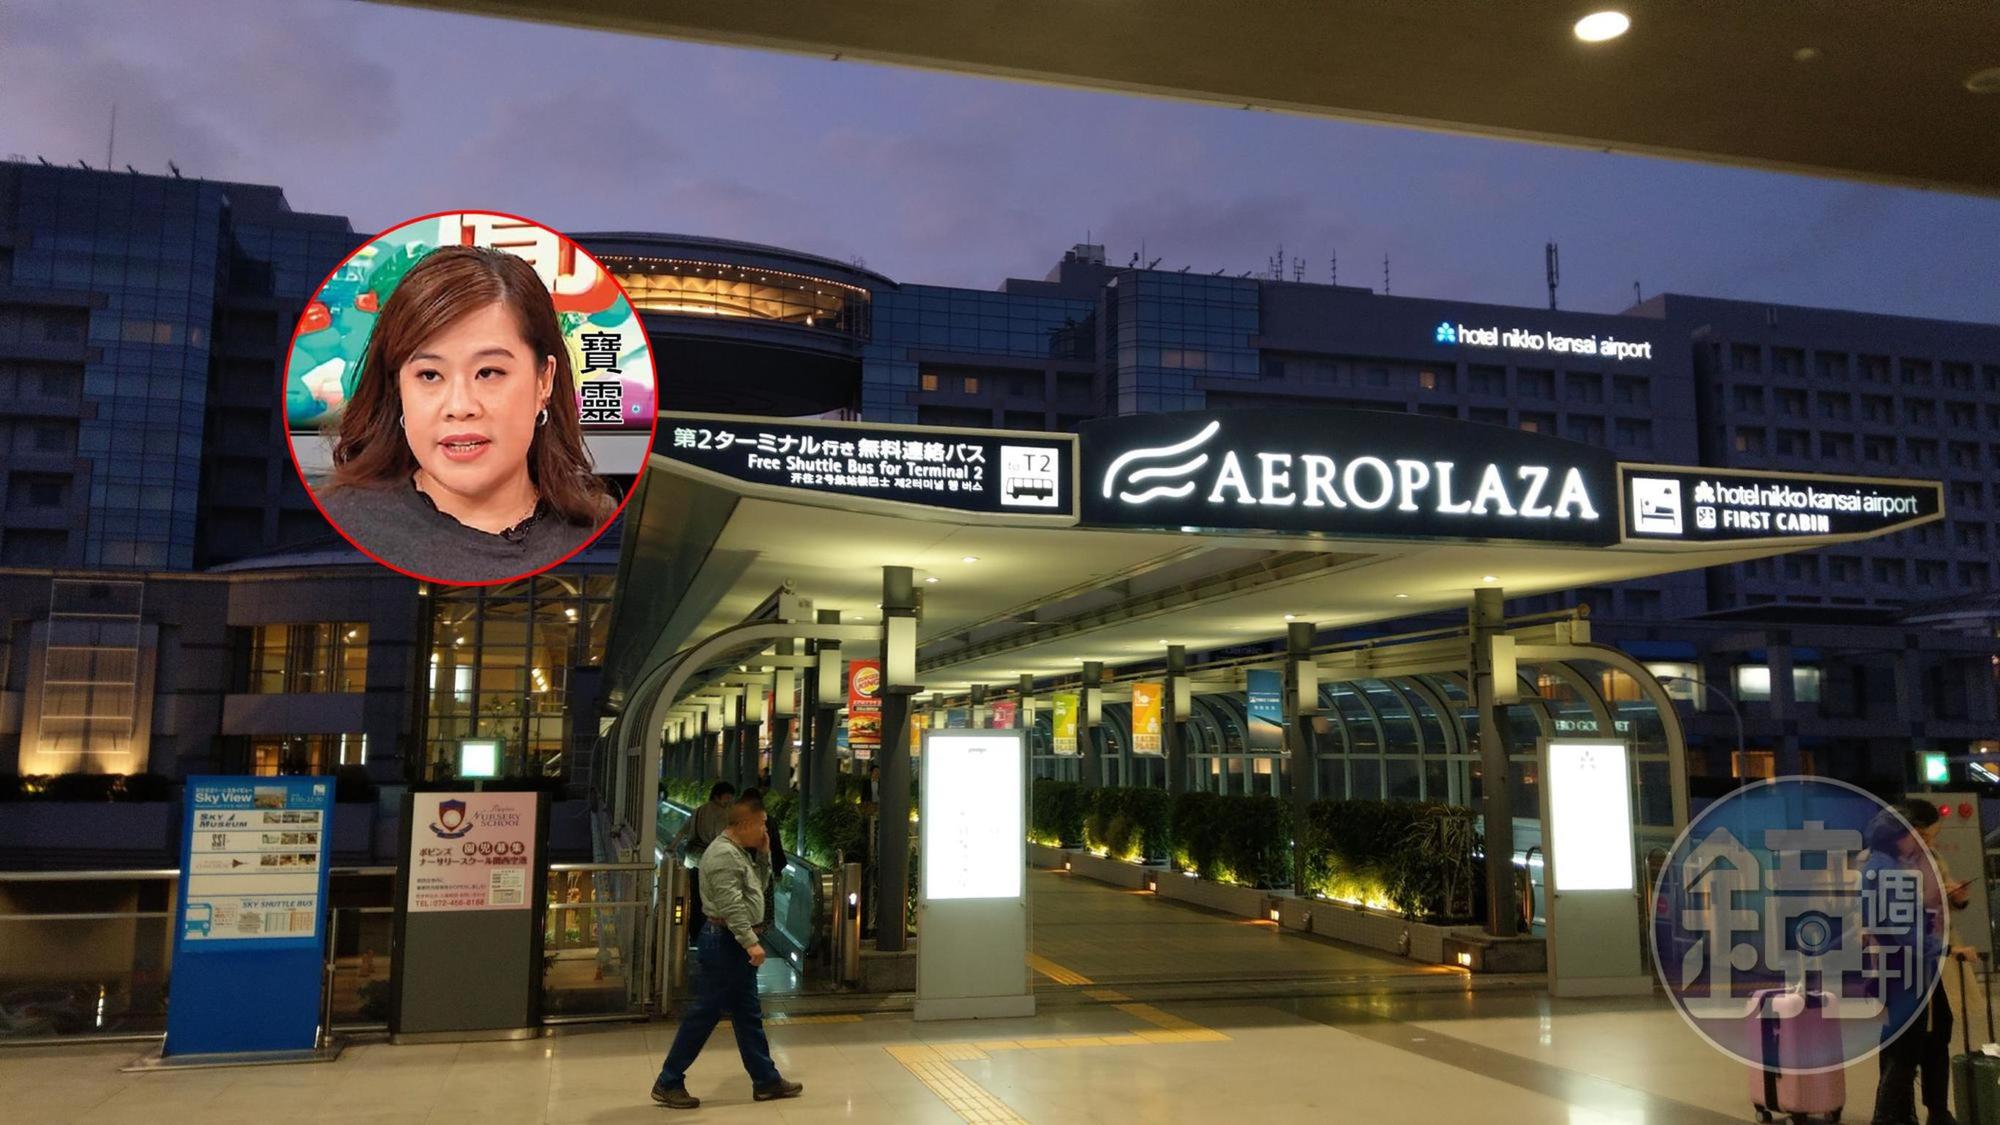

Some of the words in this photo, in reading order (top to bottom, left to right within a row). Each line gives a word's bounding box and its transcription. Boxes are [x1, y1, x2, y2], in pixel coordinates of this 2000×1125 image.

[1458, 323, 1498, 347] hotel
[1502, 328, 1544, 350] nikko
[1547, 331, 1597, 354] kansai
[1600, 336, 1652, 360] airport
[858, 437, 985, 463] 無料連絡バス
[748, 453, 781, 470] Free
[786, 455, 842, 474] Shuttle
[850, 459, 877, 476] Bus
[879, 460, 901, 477] for
[908, 462, 968, 479] Terminal
[973, 466, 983, 480] 2
[894, 477, 945, 491] 제2터미널
[948, 480, 959, 492] 행
[961, 481, 984, 492] 버스
[1207, 450, 1599, 520] AEROPLAZA
[1716, 482, 1759, 505] hotel
[1761, 484, 1808, 509] nikko
[1809, 486, 1862, 512] kansai
[1863, 491, 1918, 517] airport
[1723, 509, 1770, 530] FIRST
[1776, 512, 1829, 532] CABIN
[1555, 719, 1576, 731] ERO
[195, 792, 220, 804] Sky
[221, 792, 252, 802] View
[200, 813, 223, 821] SKY
[474, 811, 521, 821] NURSERY
[199, 820, 248, 828] MUSEUM
[261, 900, 295, 908] SHUTTLE
[297, 899, 313, 907] BUS
